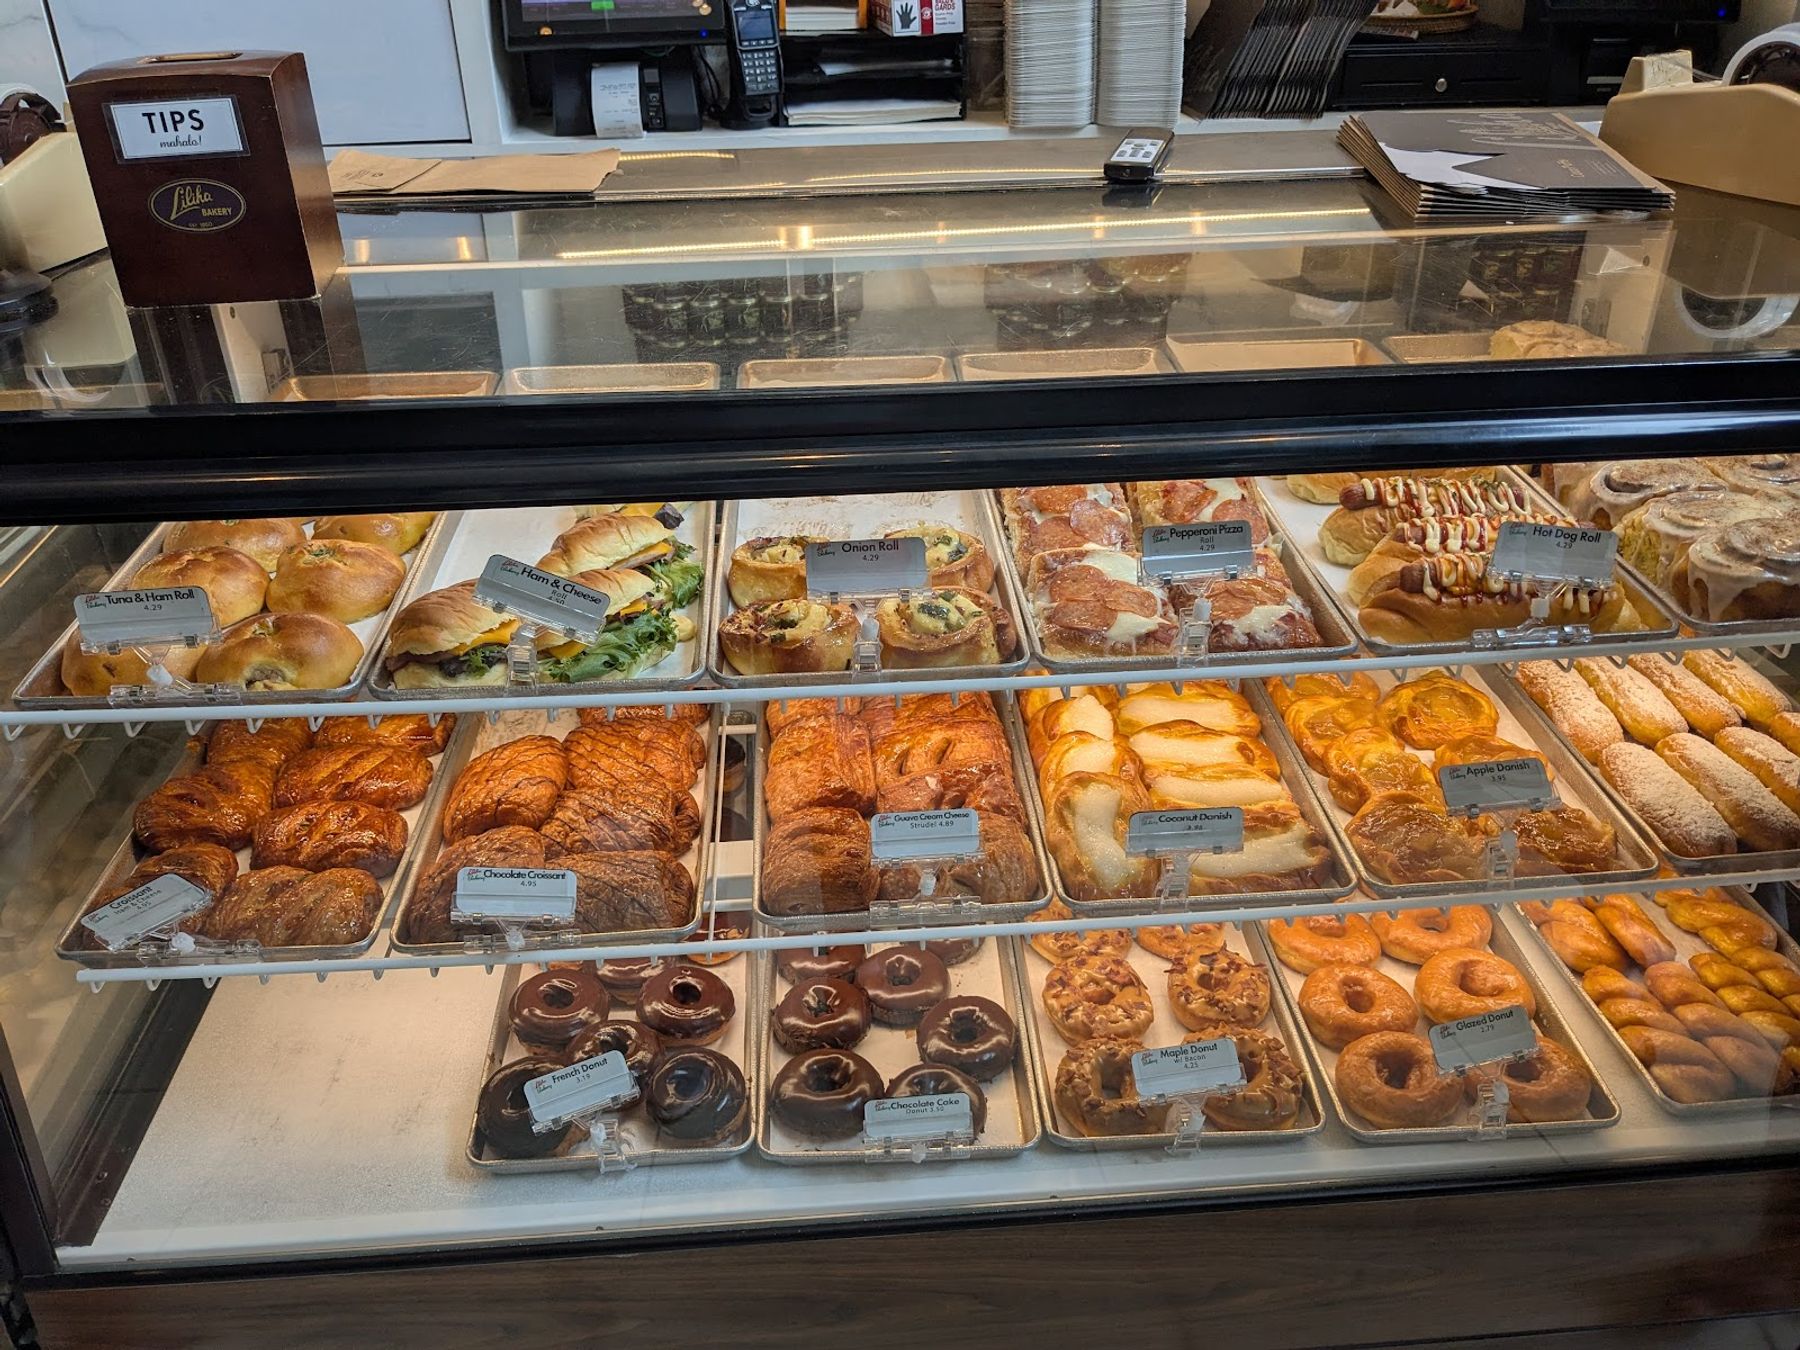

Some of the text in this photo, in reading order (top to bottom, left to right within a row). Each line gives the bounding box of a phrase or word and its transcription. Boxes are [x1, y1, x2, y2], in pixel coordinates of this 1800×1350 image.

[141, 109, 204, 134] TIPS
[160, 134, 202, 148] mahalo!
[170, 185, 213, 220] Liliha
[201, 207, 232, 217] BAKERY
[1169, 524, 1243, 540] Pepperoni Pizza
[1533, 526, 1553, 537] Hot
[1555, 529, 1578, 542] Dog
[1580, 531, 1602, 543] Roll
[842, 542, 876, 553] Onion
[879, 541, 899, 552] Roll
[521, 566, 549, 585] Ham
[550, 580, 561, 590] &
[562, 583, 602, 605] Cheese
[105, 589, 195, 605] Tuna & Ham Roll
[551, 589, 568, 600] Roll
[1466, 764, 1495, 777] Apple
[1496, 761, 1530, 772] Danish
[894, 814, 919, 822] Guava
[943, 811, 970, 820] Cheese
[1158, 814, 1198, 823] Coconut
[1199, 811, 1232, 820] Danish
[910, 821, 937, 829] Strudel
[483, 869, 566, 880] Chocolate Croissant
[109, 886, 153, 910] Croissant
[1455, 1010, 1514, 1031] Glazed Donut
[1160, 1046, 1189, 1059] Maple
[1190, 1043, 1218, 1054] Donut
[552, 1058, 608, 1083] French Donut
[576, 1073, 591, 1083] 3.19
[890, 1100, 935, 1110] Chocolate
[936, 1098, 960, 1106] Cake
